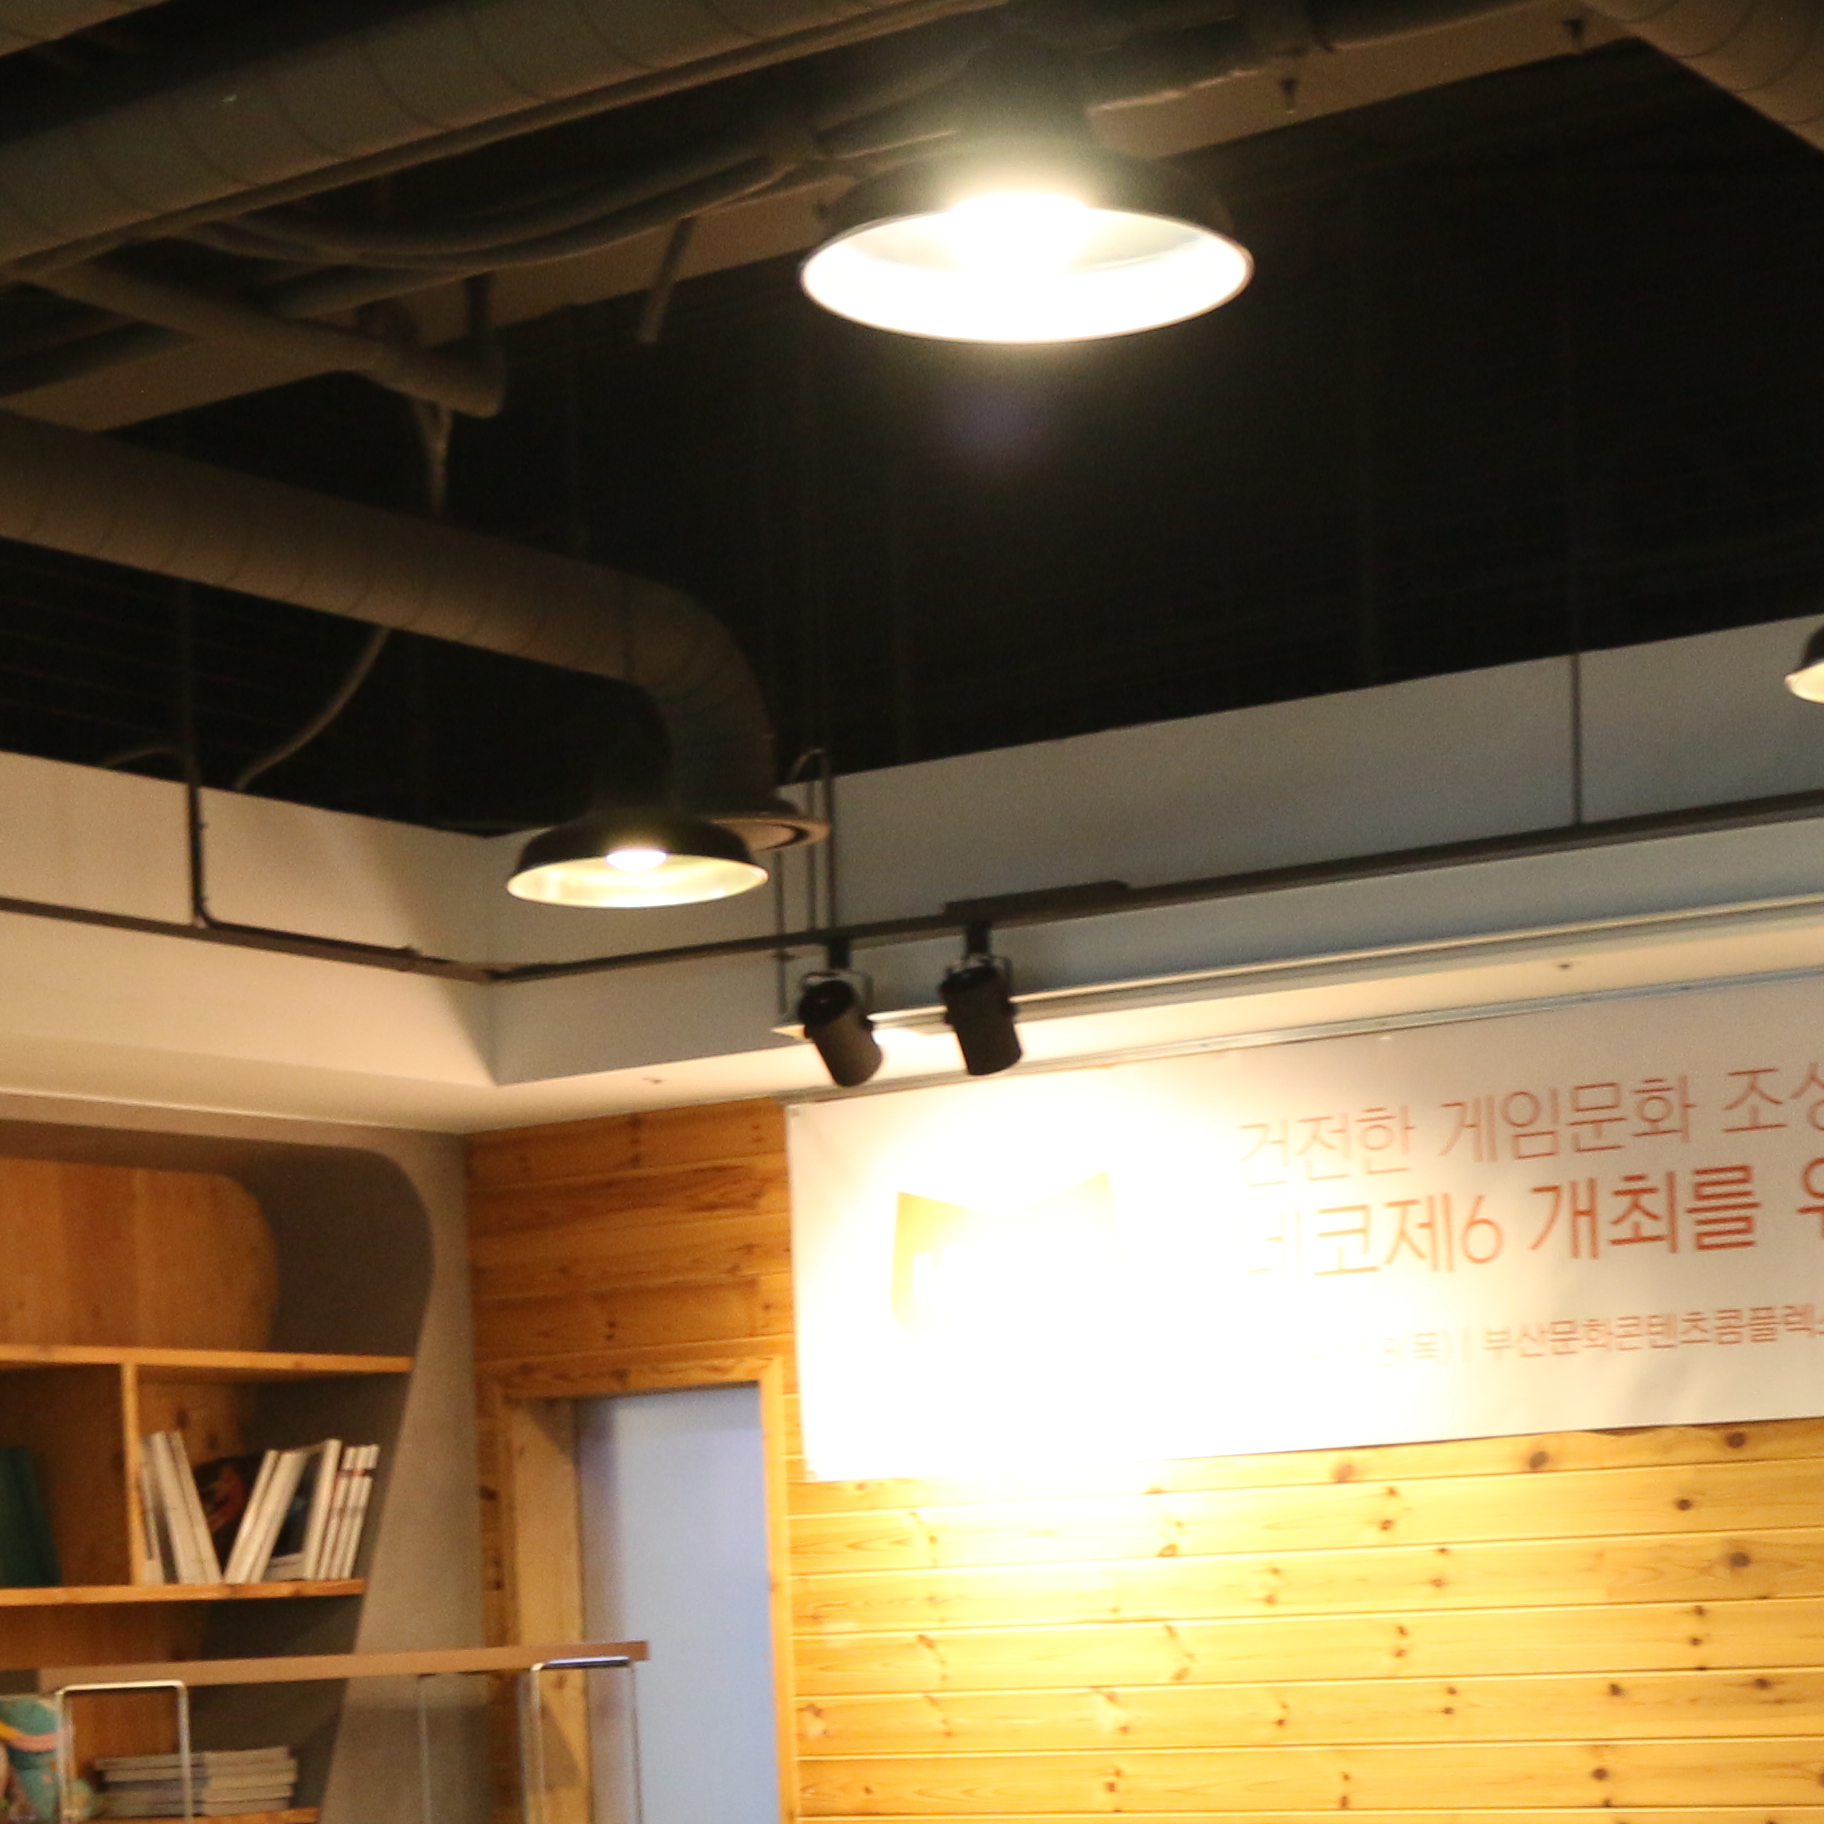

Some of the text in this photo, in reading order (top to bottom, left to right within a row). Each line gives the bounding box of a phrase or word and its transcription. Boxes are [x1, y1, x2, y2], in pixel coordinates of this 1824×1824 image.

[1238, 1104, 1416, 1188] 건전한
[1439, 1072, 1696, 1164] 게임문화
[1529, 1162, 1762, 1261] 개최를
